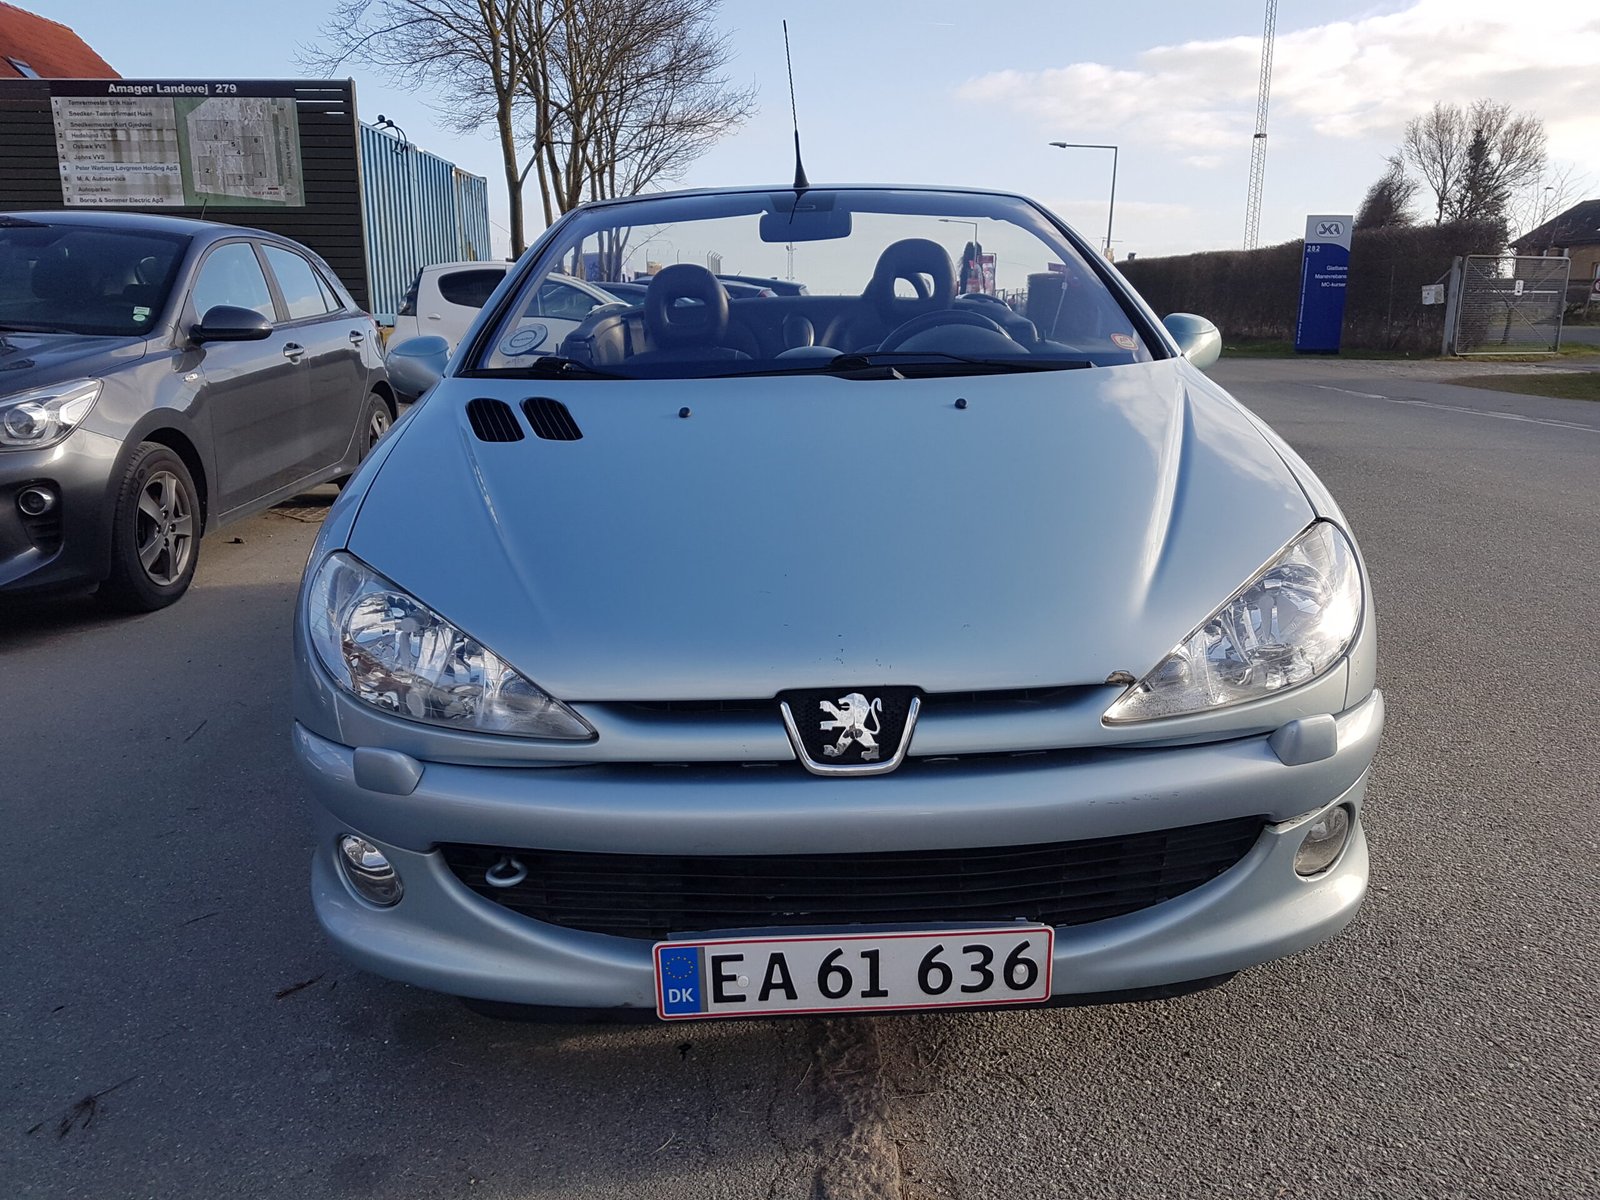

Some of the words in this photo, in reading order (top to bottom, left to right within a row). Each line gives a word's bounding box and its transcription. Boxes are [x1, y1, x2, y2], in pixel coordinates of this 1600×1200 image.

[108, 83, 154, 95] Amager
[156, 83, 208, 95] Landevej
[216, 84, 237, 93] 279
[710, 951, 798, 1004] EA
[817, 947, 889, 1000] 61
[917, 940, 1040, 995] 636
[668, 988, 695, 1004] DK
